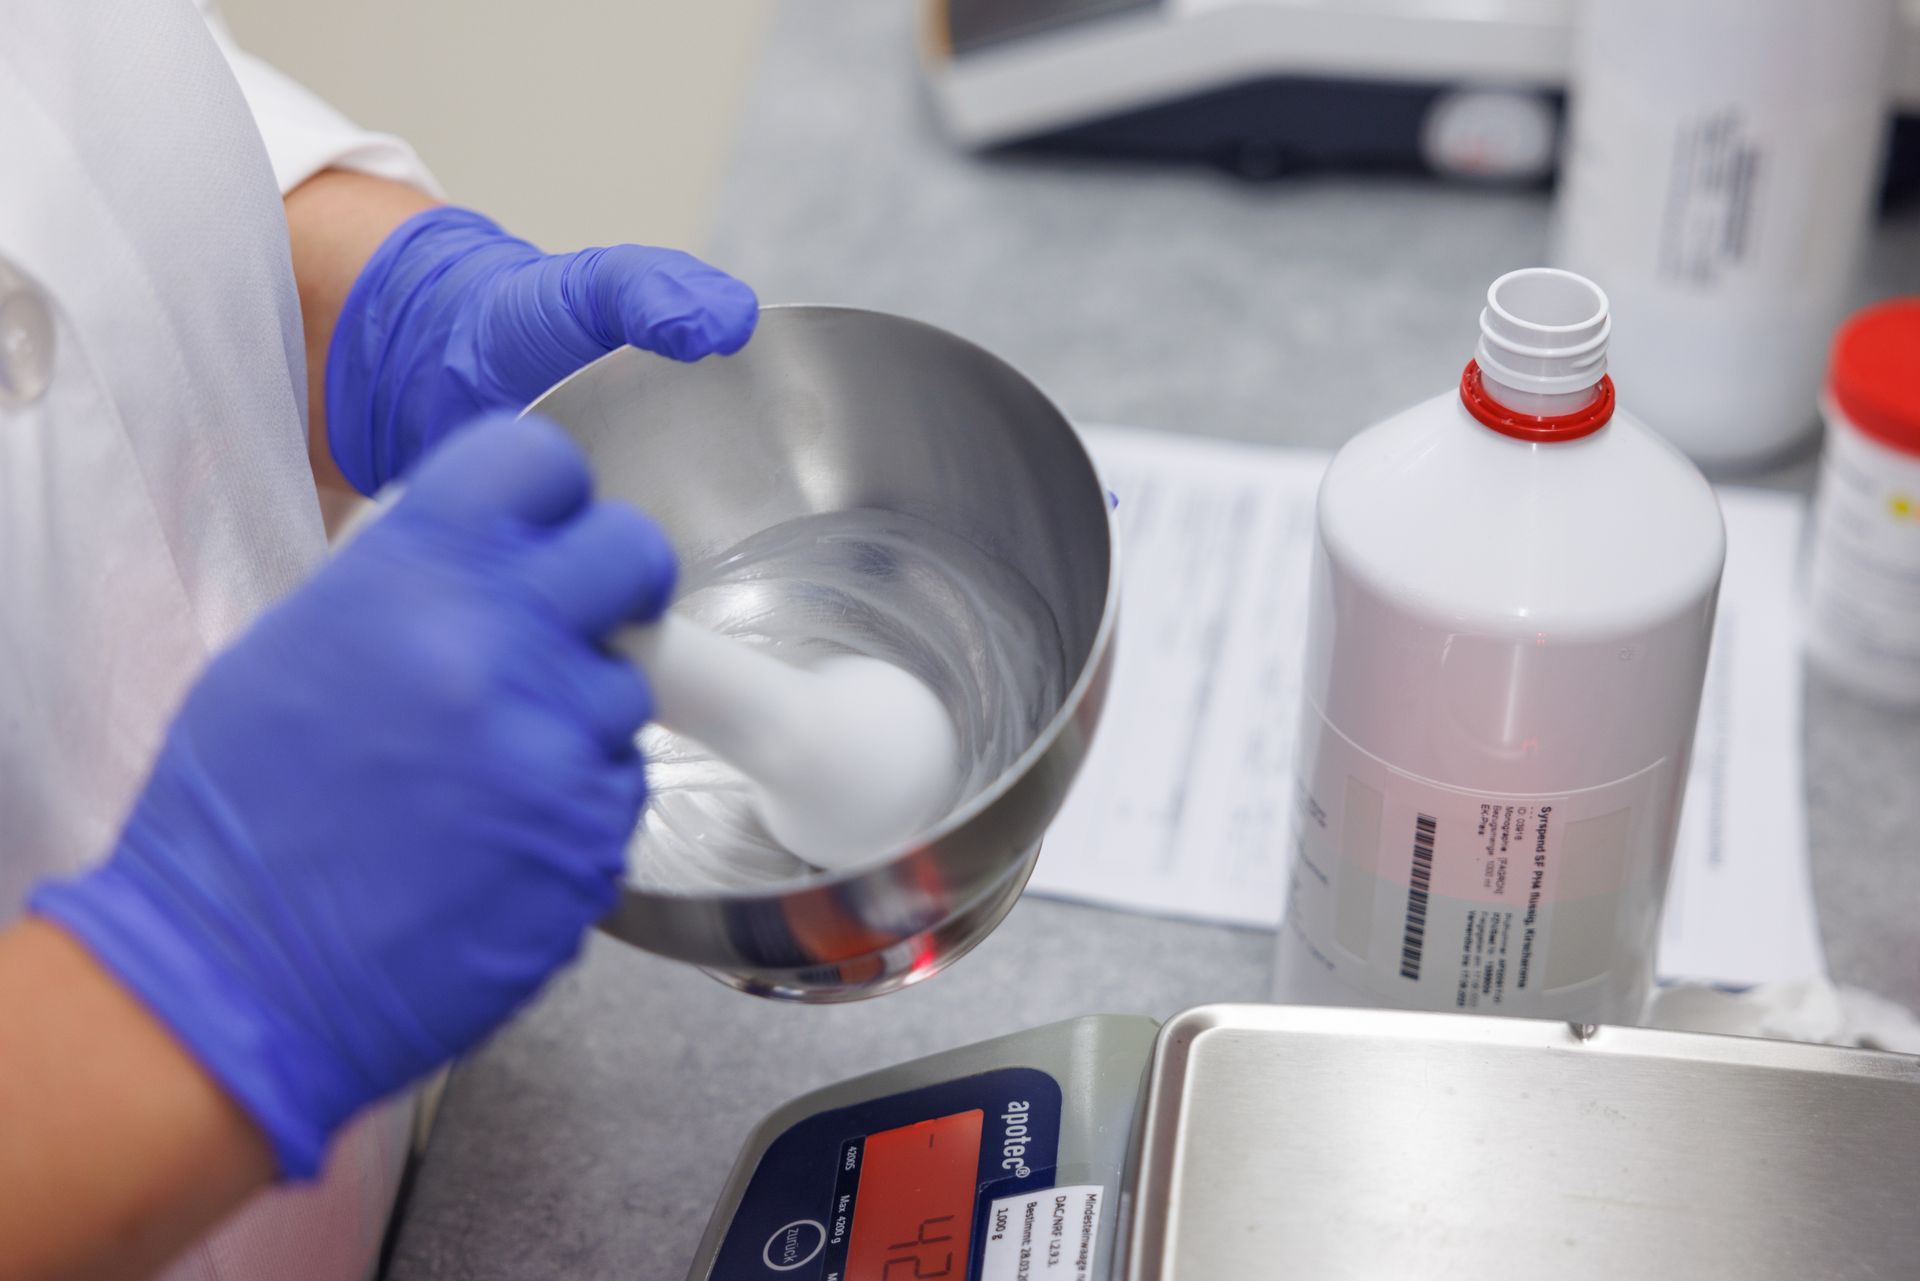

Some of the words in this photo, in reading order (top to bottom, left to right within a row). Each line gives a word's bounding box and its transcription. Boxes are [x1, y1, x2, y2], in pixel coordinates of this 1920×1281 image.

[1535, 806, 1552, 852] Syrspend
[1535, 855, 1545, 867] SF
[838, 1194, 850, 1213] Max
[1052, 1195, 1066, 1236] DAC/NRF
[834, 1215, 846, 1236] 4200
[996, 1207, 1009, 1232] 1,000
[1076, 1193, 1096, 1271] Mindesteinwaage
[783, 1227, 799, 1264] zurück
